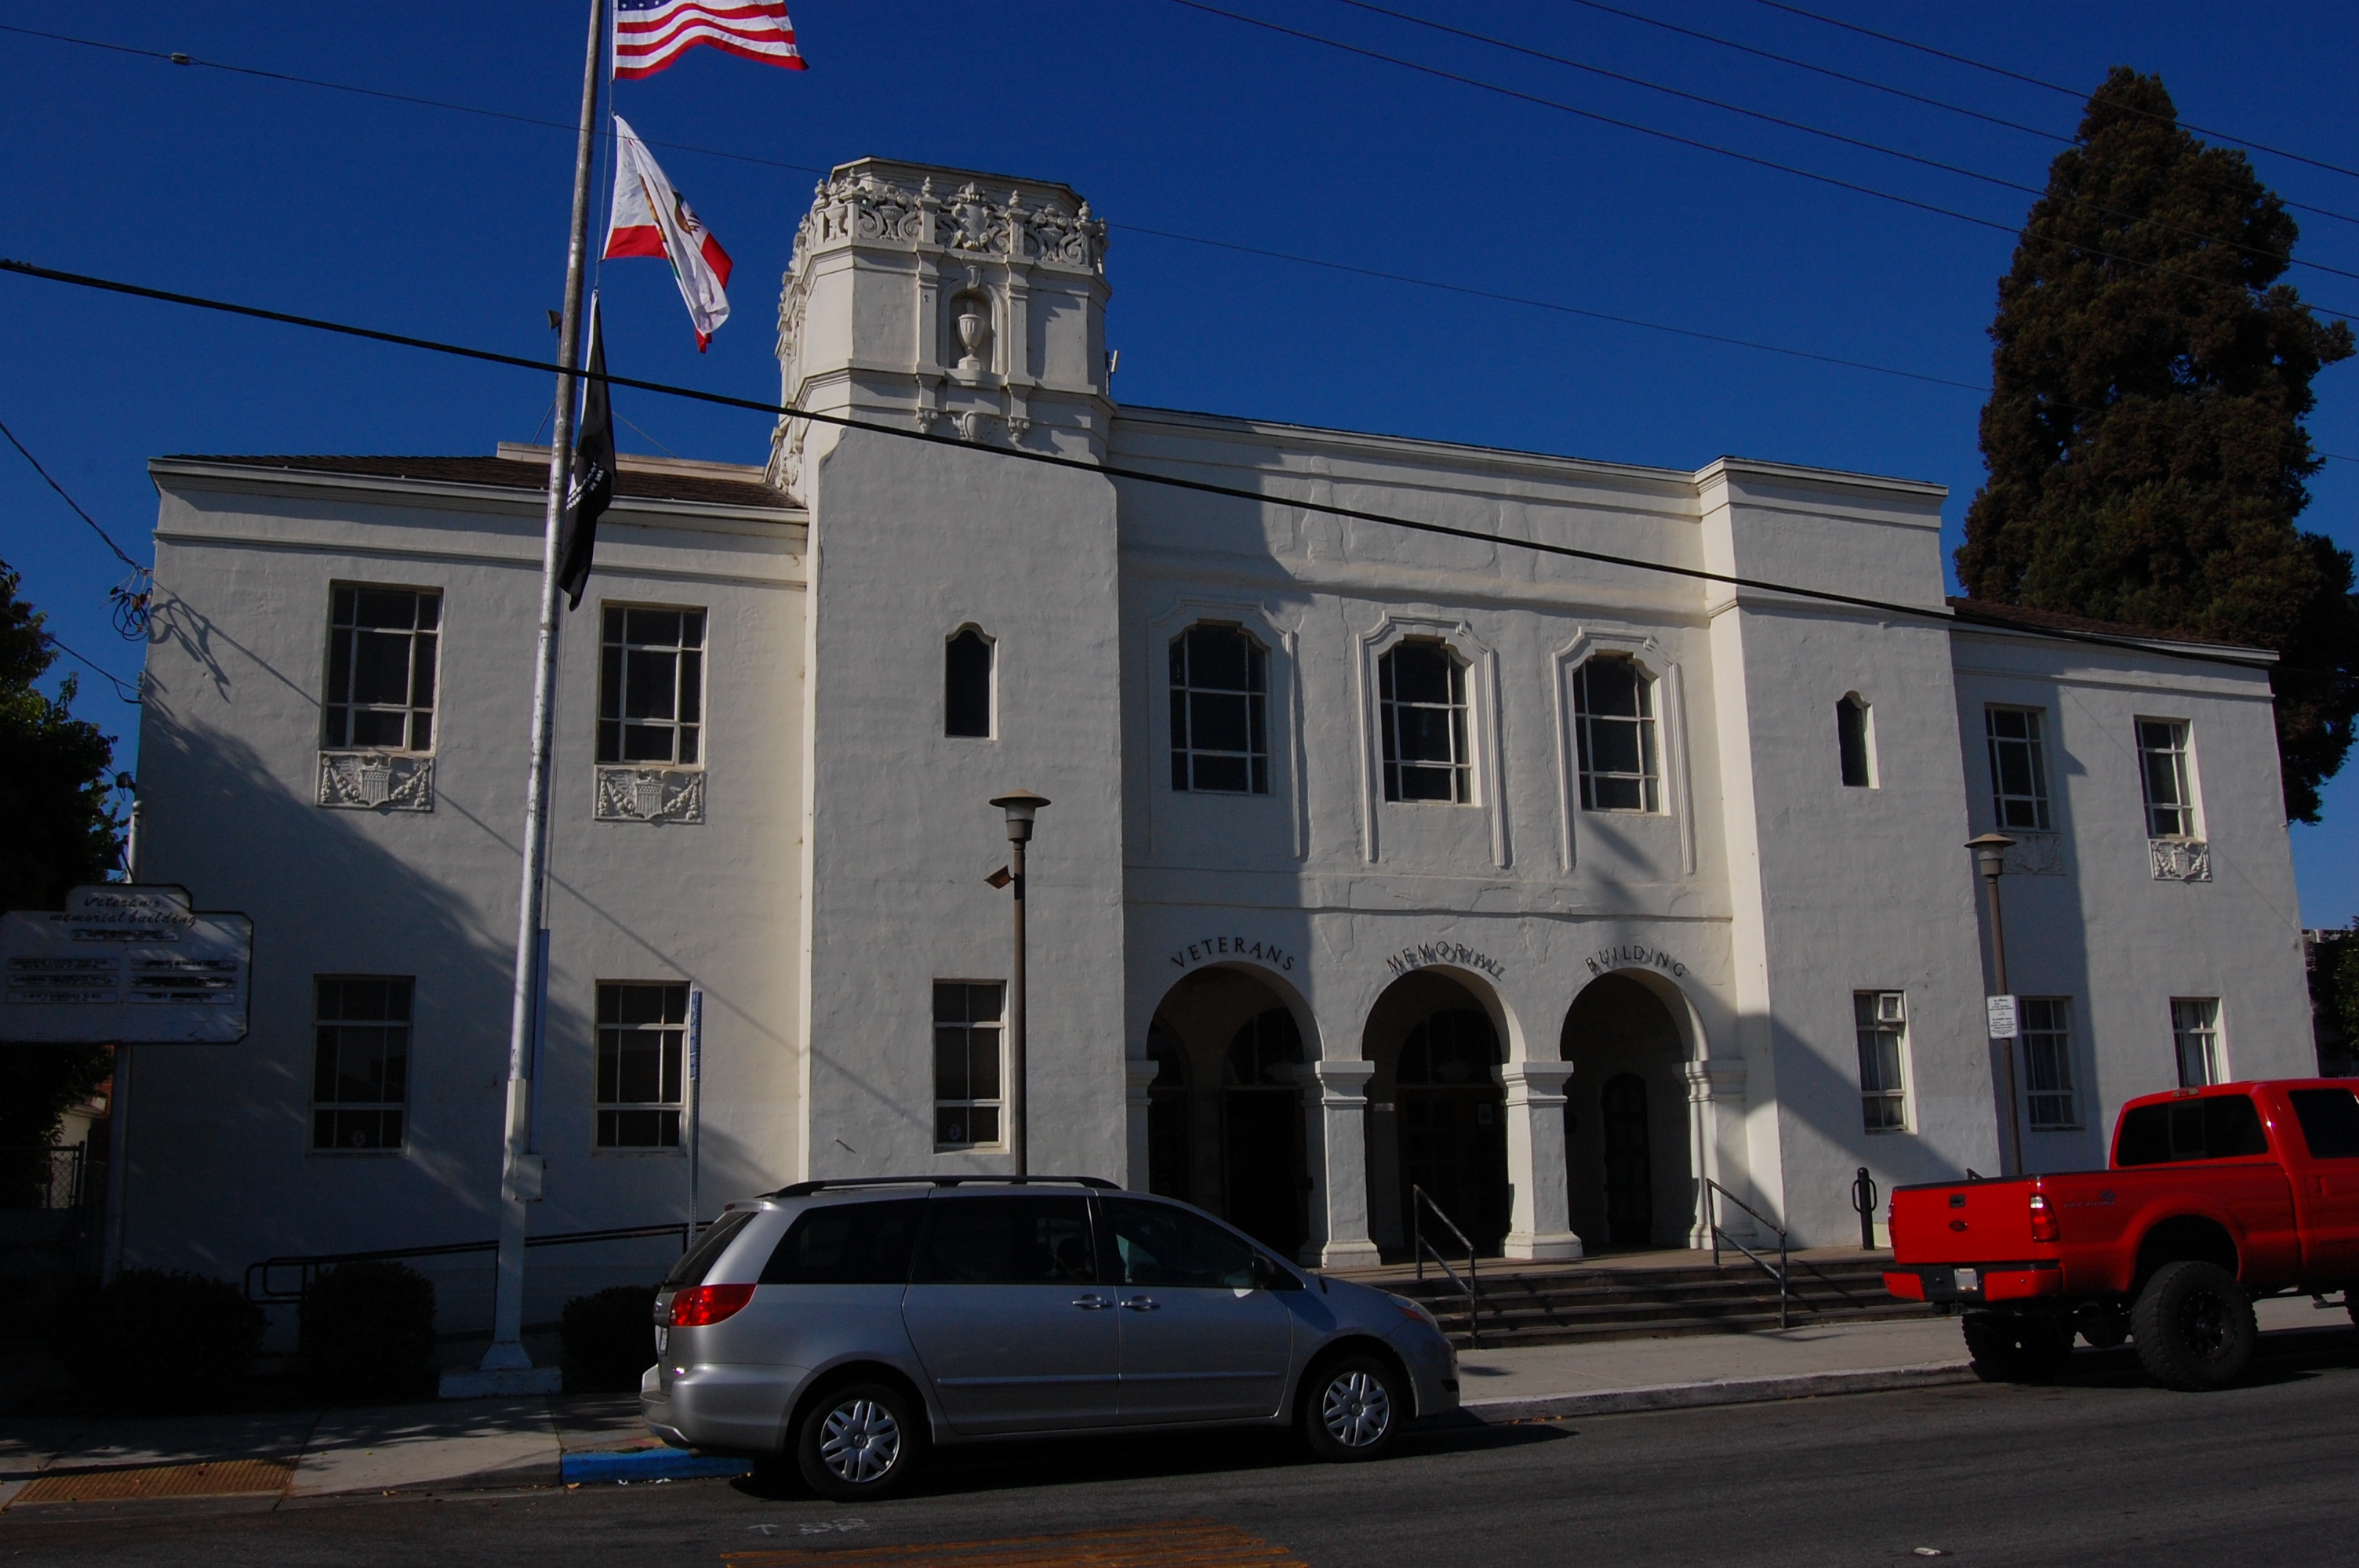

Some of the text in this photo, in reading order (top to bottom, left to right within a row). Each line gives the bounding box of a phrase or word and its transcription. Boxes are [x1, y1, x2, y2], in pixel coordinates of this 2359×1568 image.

[49, 909, 196, 928] memorial building
[1171, 936, 1685, 978] VETERANS MEMORIAL BUILDING
